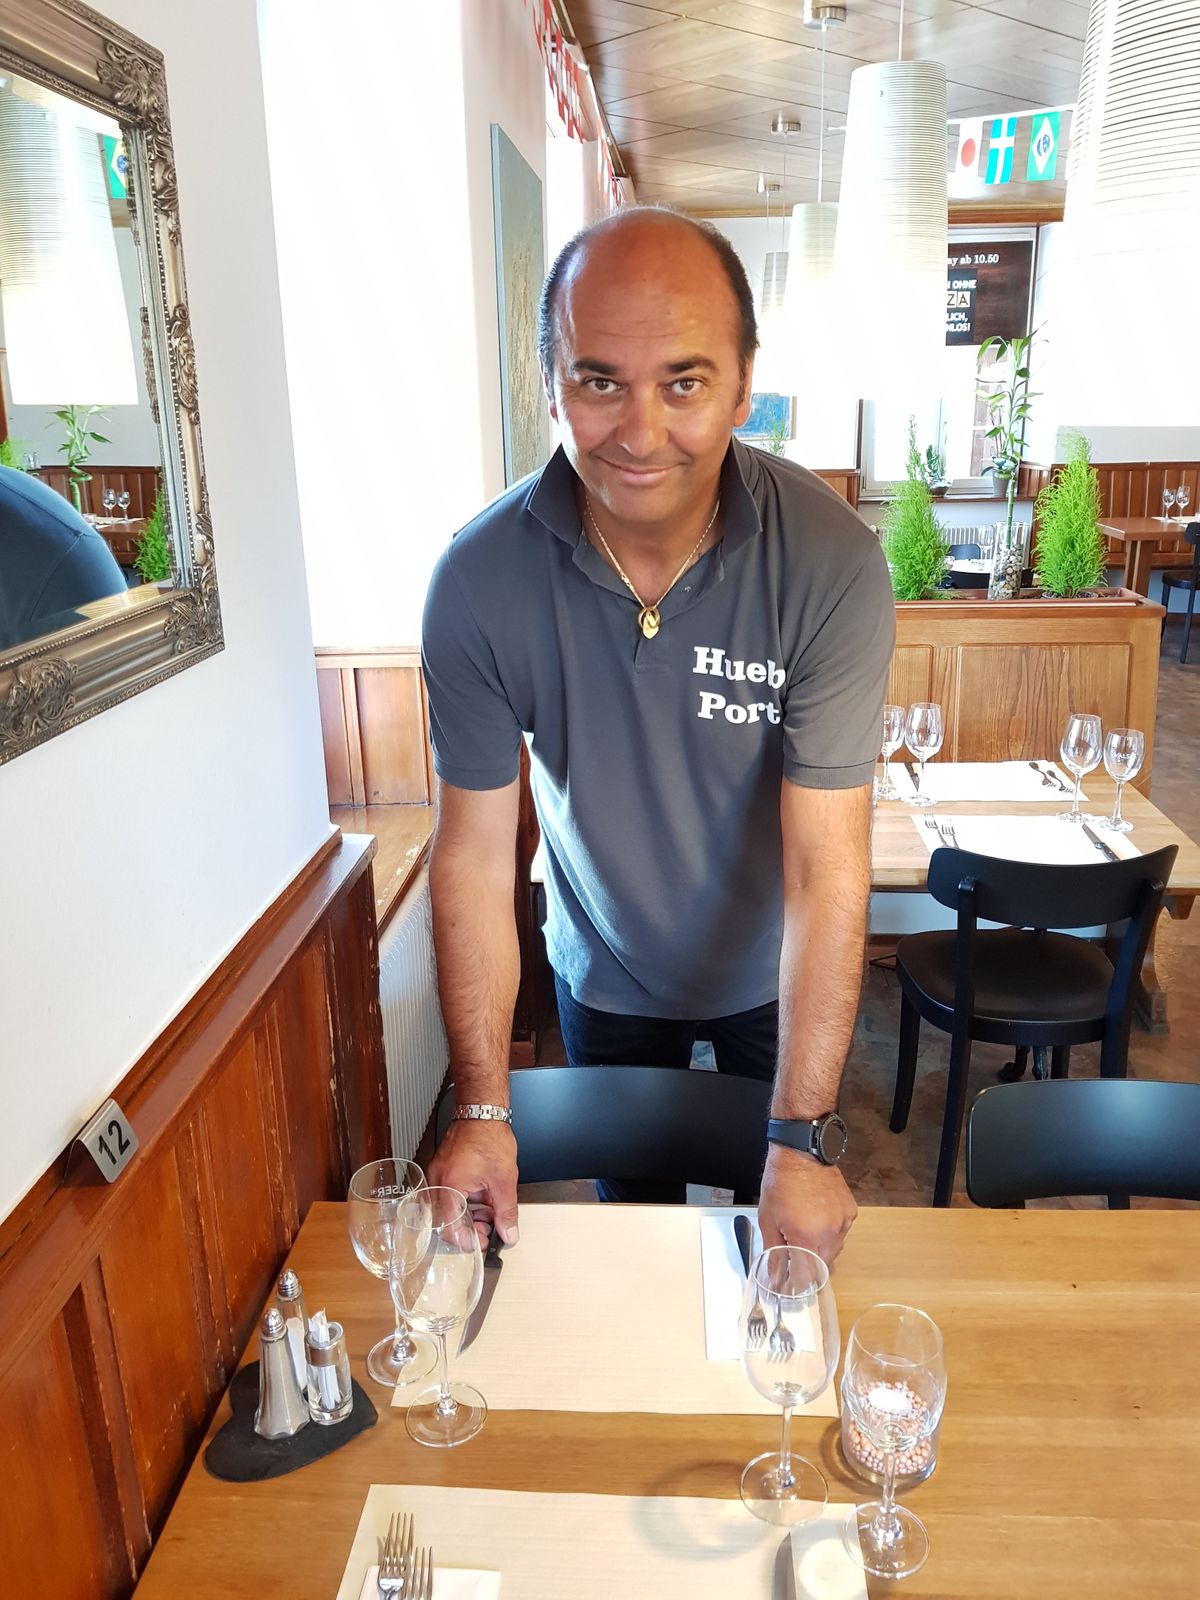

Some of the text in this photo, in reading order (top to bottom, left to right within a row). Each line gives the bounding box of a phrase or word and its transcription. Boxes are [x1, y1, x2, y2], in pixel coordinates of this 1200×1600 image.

[960, 254, 972, 264] ab
[952, 280, 977, 289] OHNE
[693, 646, 786, 689] Hueb
[698, 691, 781, 724] Port
[98, 1119, 131, 1165] 12
